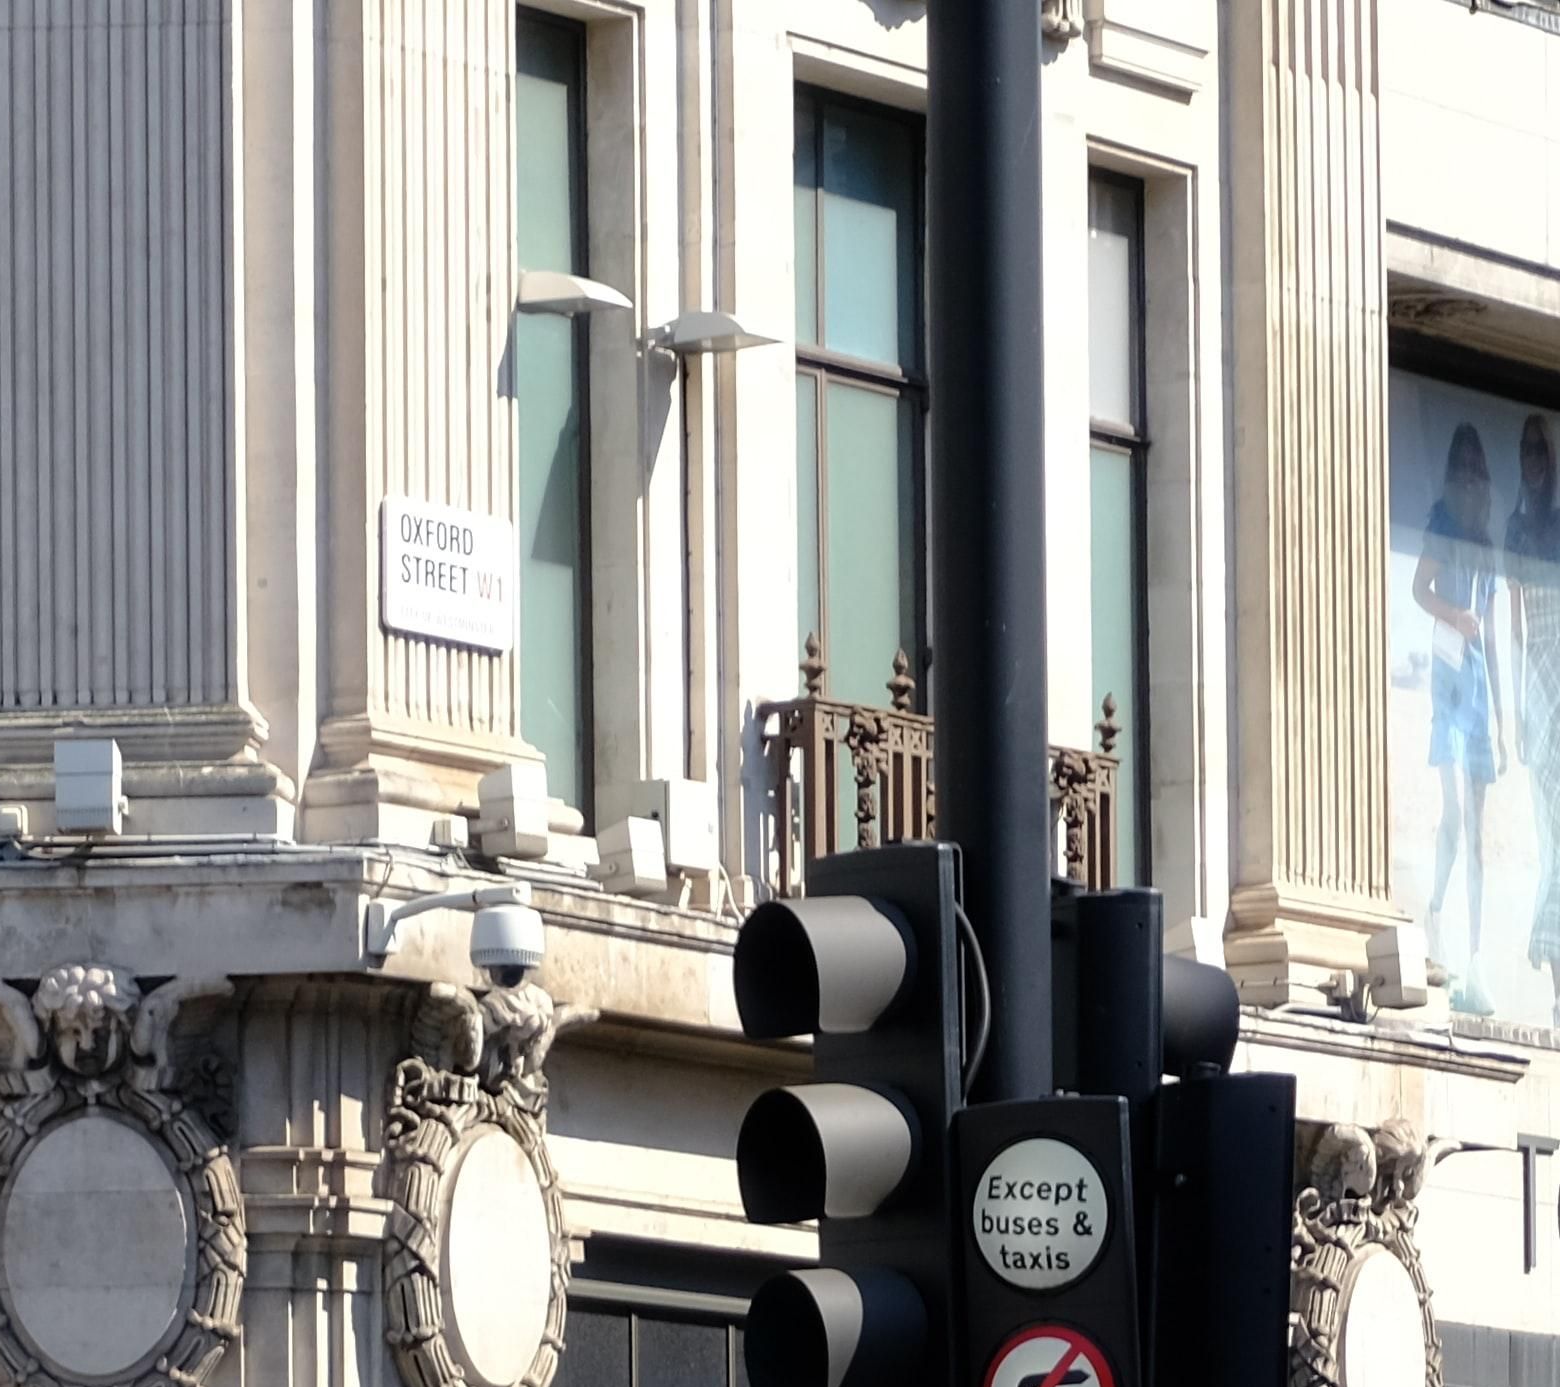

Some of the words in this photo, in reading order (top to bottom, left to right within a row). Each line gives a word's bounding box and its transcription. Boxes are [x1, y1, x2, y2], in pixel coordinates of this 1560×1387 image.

[400, 513, 474, 556] OXFORD
[400, 554, 468, 596] STREET
[477, 569, 504, 603] W1
[987, 1175, 1088, 1205] Except
[981, 1209, 1059, 1236] buses
[1072, 1211, 1093, 1236] &
[999, 1245, 1071, 1271] taxis
